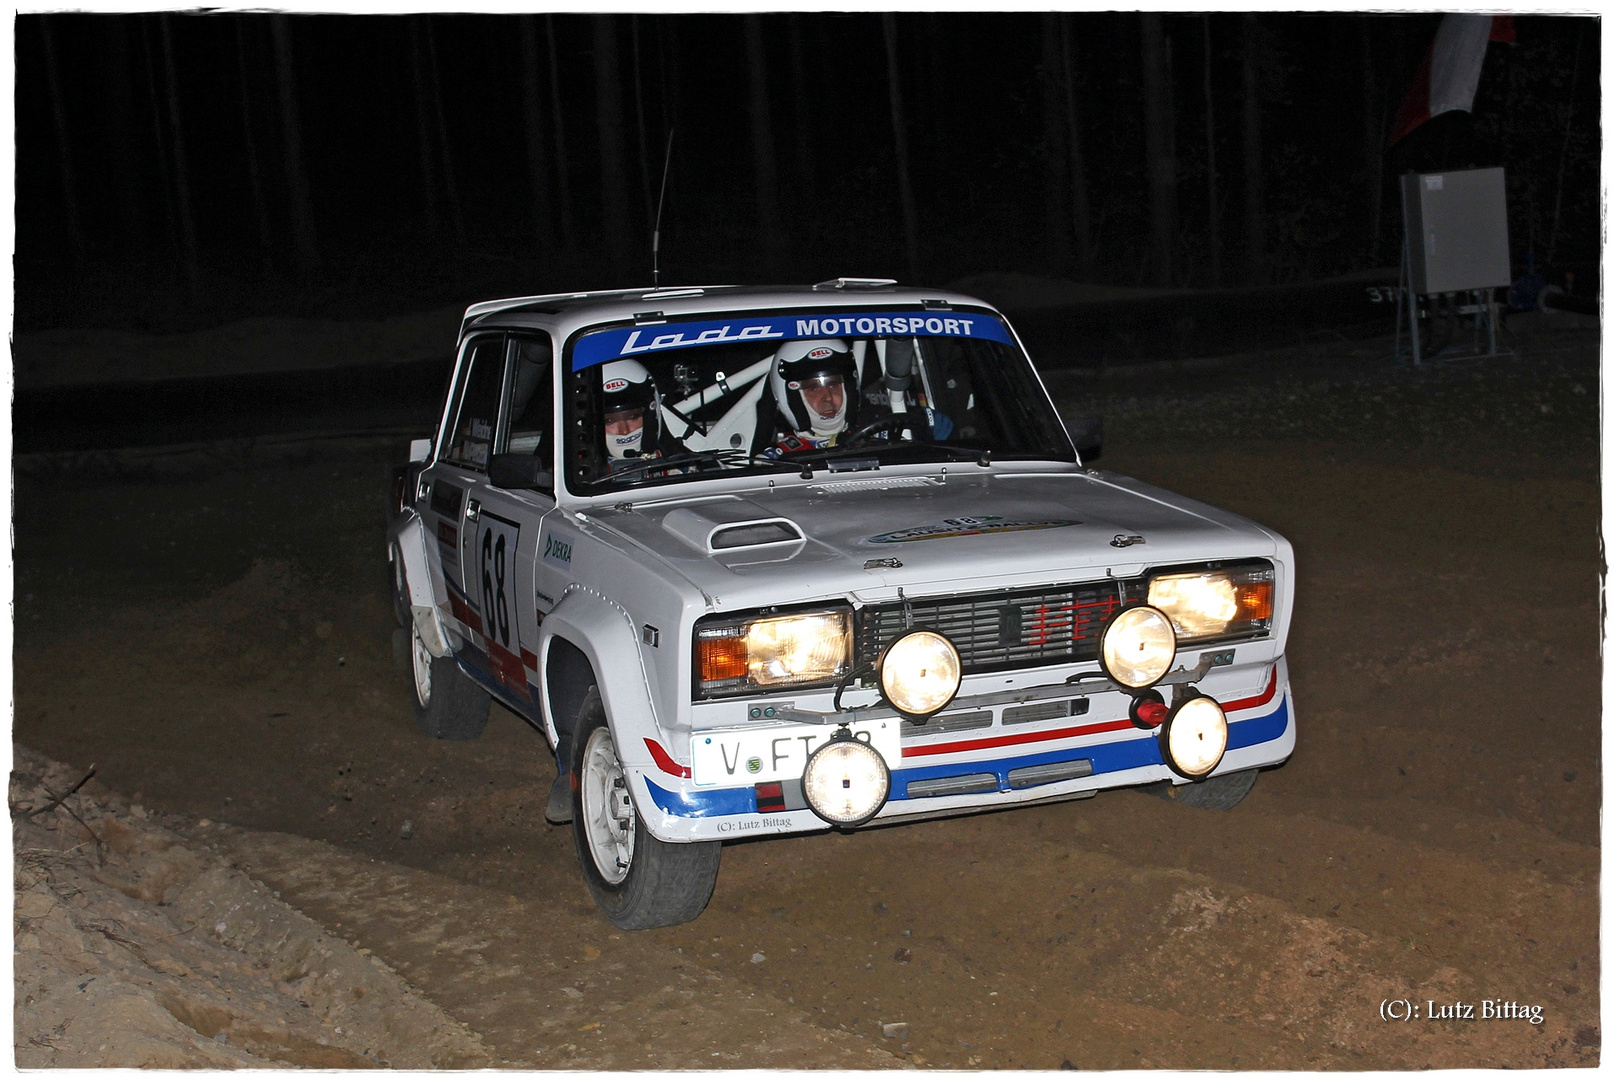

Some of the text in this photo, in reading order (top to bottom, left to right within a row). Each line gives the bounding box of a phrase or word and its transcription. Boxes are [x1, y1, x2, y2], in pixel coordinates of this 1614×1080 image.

[619, 318, 974, 355] Lada MOTORSPORT
[605, 381, 626, 390] BELL
[552, 539, 573, 564] DEKRA
[481, 527, 511, 648] 68
[720, 741, 741, 775] V
